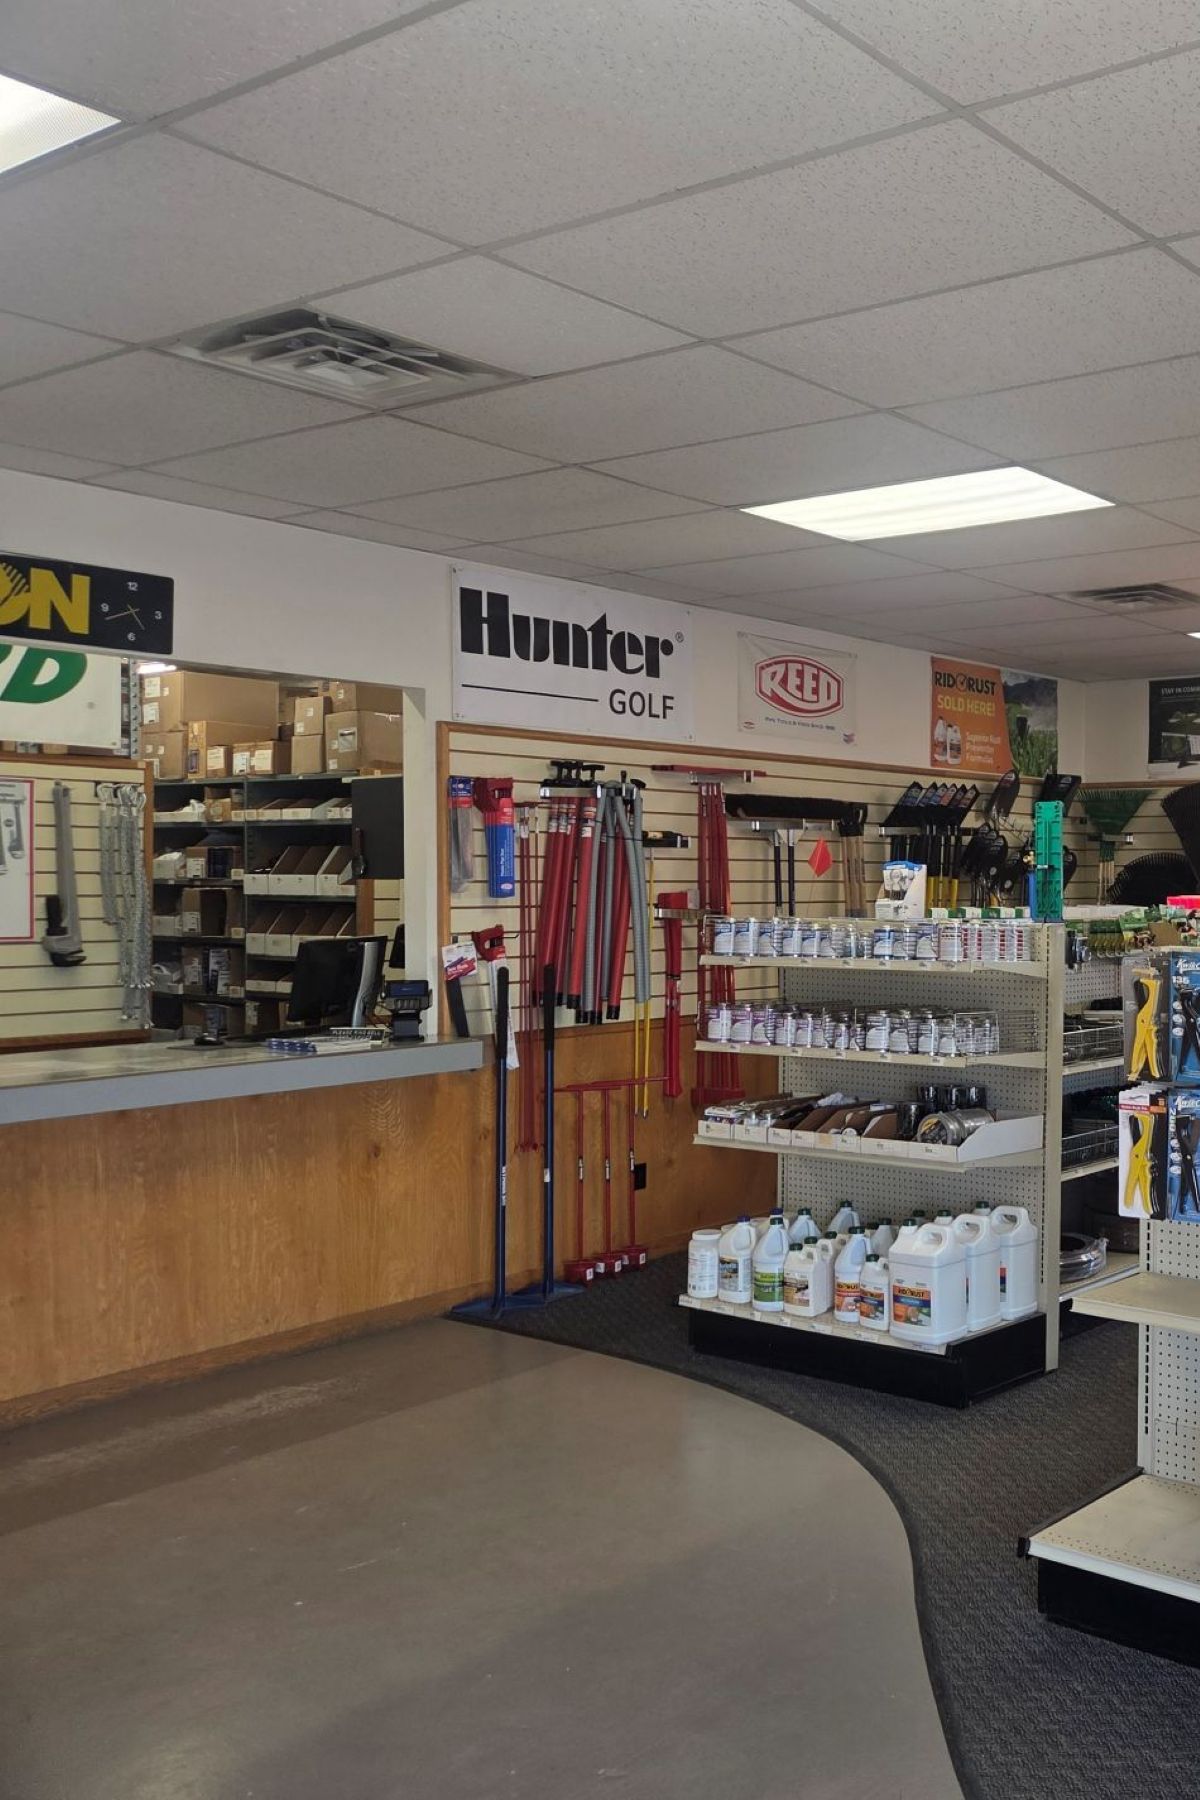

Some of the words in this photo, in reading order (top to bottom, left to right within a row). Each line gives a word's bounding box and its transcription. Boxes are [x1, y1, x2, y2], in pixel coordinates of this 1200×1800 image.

[127, 581, 138, 591] 12
[100, 602, 110, 612] 9
[154, 610, 162, 620] 3
[127, 632, 136, 641] 6
[459, 586, 674, 678] Hunter
[758, 662, 834, 705] REED
[608, 688, 675, 720] GOLF
[937, 694, 965, 712] SOLD
[966, 698, 996, 717] HERE!
